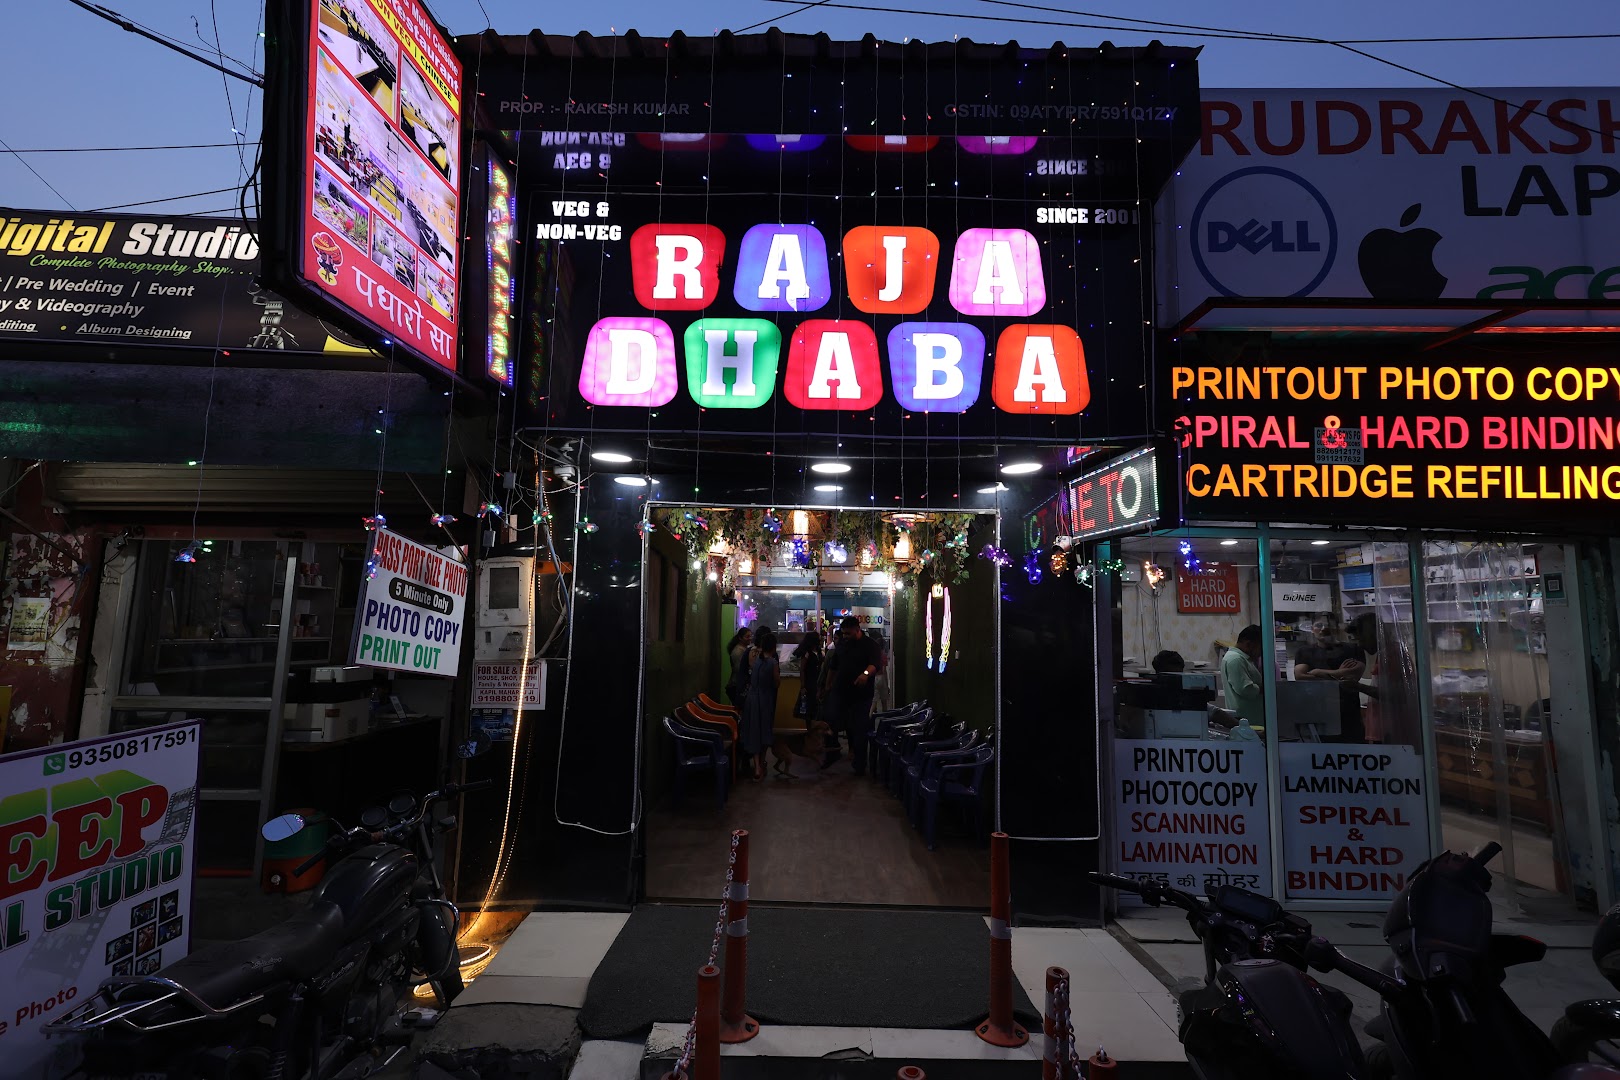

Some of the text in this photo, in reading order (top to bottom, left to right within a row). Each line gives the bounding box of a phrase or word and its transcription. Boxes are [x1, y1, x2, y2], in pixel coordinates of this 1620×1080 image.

[412, 2, 459, 77] Multi Cuisine
[394, 18, 411, 47] VEG
[420, 55, 452, 101] CHINESE
[500, 100, 545, 114] PROP.
[564, 102, 629, 115] RAKESH
[633, 103, 690, 115] KUMAR
[943, 103, 1004, 118] GSTIN:
[552, 201, 610, 217] VEG &
[1036, 207, 1140, 225] SINCE 2001
[121, 222, 260, 260] Studio
[536, 223, 622, 241] NON-VEG
[1207, 217, 1320, 255] DELL
[29, 254, 94, 271] Complete
[98, 256, 190, 275] Photography
[652, 232, 1026, 304] RAJA
[15, 276, 195, 297] Pre Wedding Event
[15, 298, 33, 311] &
[37, 299, 145, 318] Videography
[352, 265, 454, 360] पधारो सा
[77, 322, 122, 336] Album
[125, 325, 193, 340] Designing
[605, 328, 1068, 403] DHABA
[1172, 366, 1368, 400] PRINTOUT
[1379, 366, 1515, 401] PHOTO
[1174, 415, 1620, 450] SPIRAL & HARD BINDIN
[1099, 466, 1142, 523] TO
[1185, 464, 1413, 498] CARTRIDGE
[1427, 464, 1620, 500] REFILLING
[376, 531, 468, 598] PASS PORT SIZE PHOTO
[395, 582, 449, 612] 5 Minute Only
[1191, 578, 1226, 593] HARD
[1183, 593, 1237, 608] BINDING
[364, 598, 460, 646] PHOTO COPY
[359, 633, 442, 670] PRINT OUT
[477, 666, 492, 675] FOR
[492, 666, 510, 675] SALE
[511, 666, 518, 675] &
[69, 727, 196, 769] 9350817591
[1133, 747, 1244, 774] PRINTOUT
[1311, 753, 1392, 771] LAPTOP
[1121, 779, 1258, 807] PHOTOCOPY
[1285, 775, 1421, 796] LAMINATION
[1131, 811, 1245, 835] SCANNING
[1299, 805, 1411, 827] SPIRAL
[1346, 828, 1365, 842] &
[1121, 841, 1258, 865] LAMINATION
[1310, 845, 1404, 866] HARD
[1288, 870, 1404, 891] BINDIN
[0, 843, 184, 953] L STUDIO
[16, 986, 78, 1027] Photo
